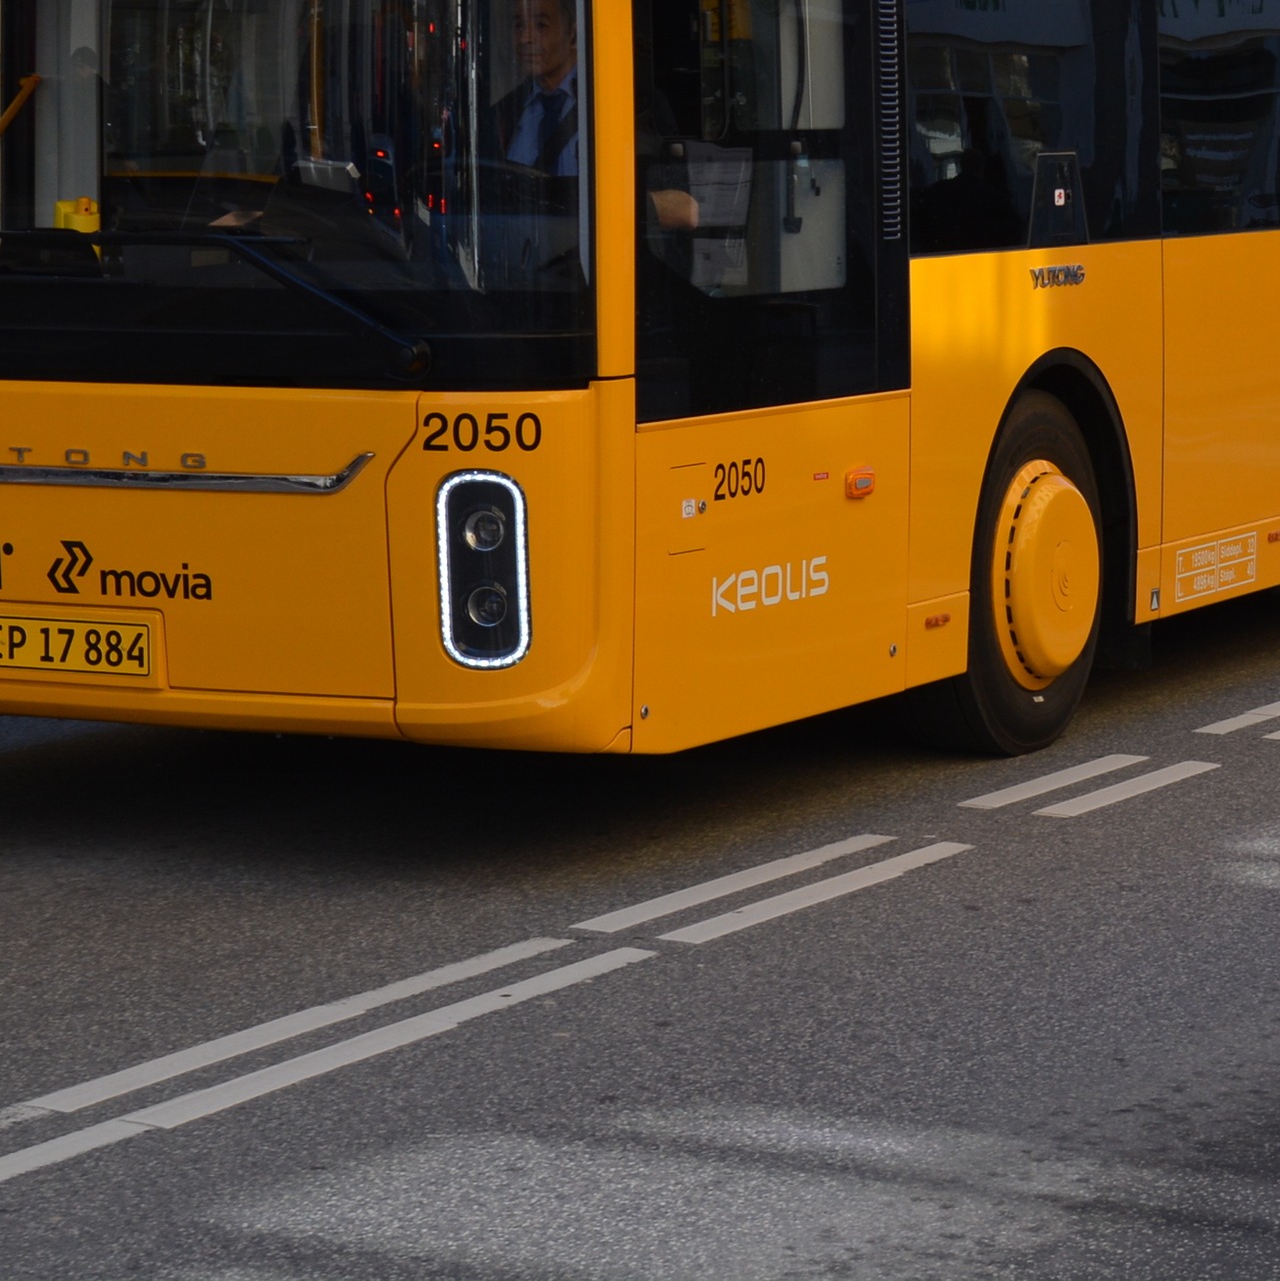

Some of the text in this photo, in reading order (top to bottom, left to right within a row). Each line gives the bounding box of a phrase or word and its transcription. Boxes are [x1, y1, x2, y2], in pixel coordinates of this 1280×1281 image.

[1029, 265, 1086, 290] YUTONG
[423, 412, 542, 451] 2050
[713, 457, 766, 501] 2050
[100, 562, 213, 600] movia
[40, 627, 75, 663] 17
[84, 629, 145, 668] 884
